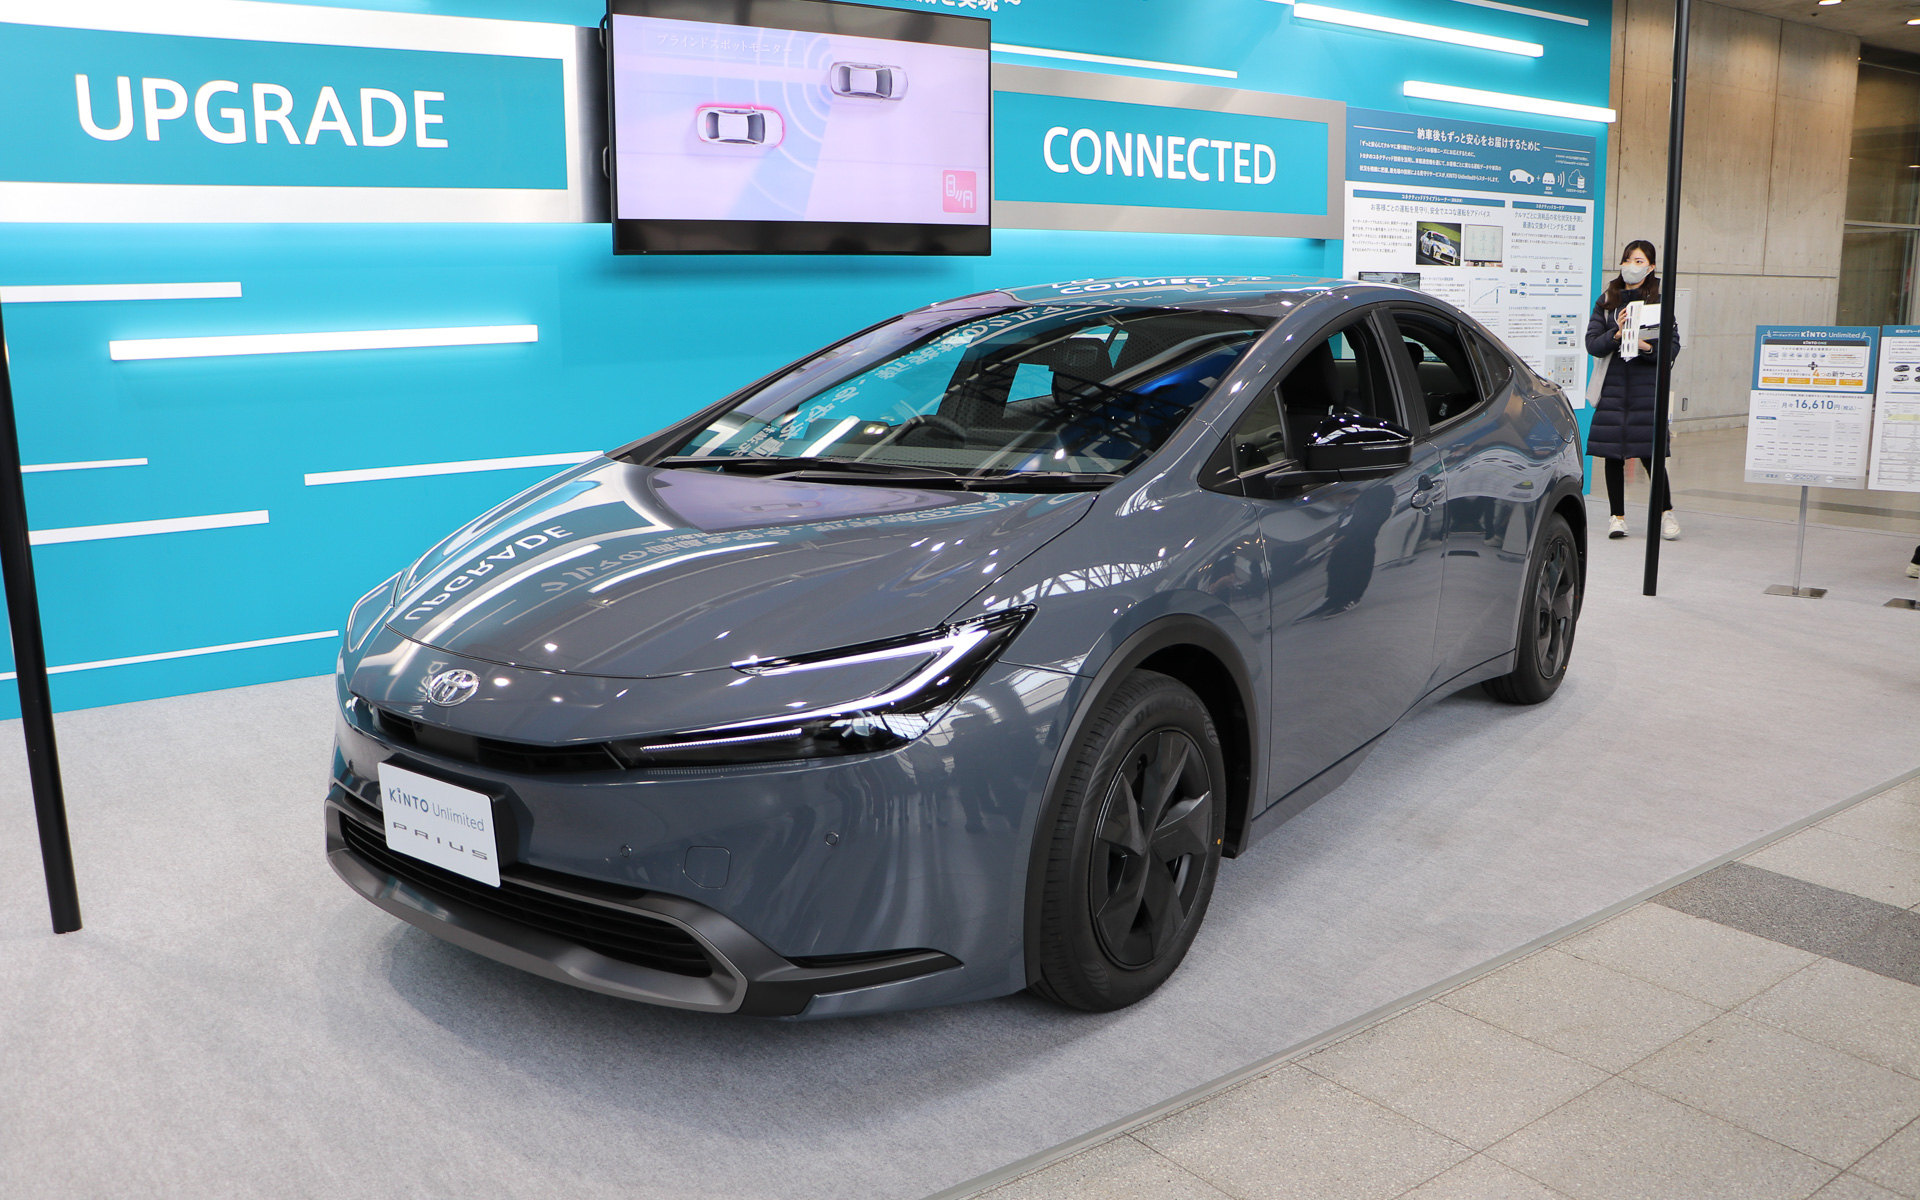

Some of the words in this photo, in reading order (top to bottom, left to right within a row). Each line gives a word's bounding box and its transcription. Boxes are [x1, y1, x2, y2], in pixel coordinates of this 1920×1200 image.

[657, 34, 793, 53] ブラインドスポットモニター
[75, 74, 449, 149] UPGRADE
[1043, 126, 1277, 185] CONNECTED
[1416, 127, 1541, 151] 納車後もずっと安心をお届けするために
[1828, 331, 1861, 339] Unlimited
[388, 787, 429, 813] KINTO
[432, 802, 485, 832] Unlimited
[393, 821, 488, 861] PRIUS
